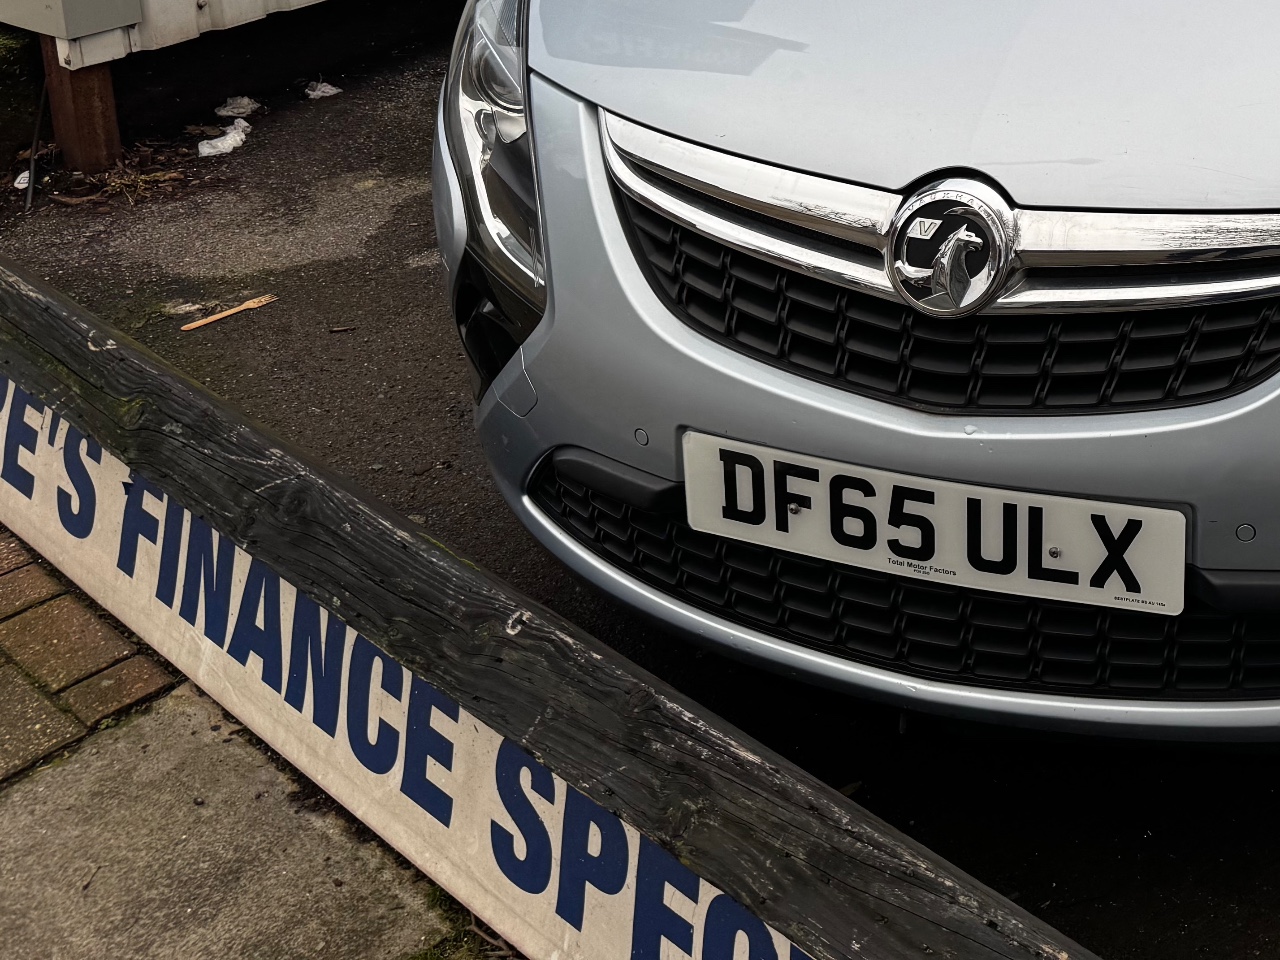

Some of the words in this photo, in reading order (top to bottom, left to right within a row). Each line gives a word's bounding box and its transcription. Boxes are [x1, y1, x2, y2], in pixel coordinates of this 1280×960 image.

[719, 448, 936, 563] DF65
[966, 496, 1143, 595] ULX
[887, 557, 905, 567] Total
[906, 561, 928, 571] Motor
[929, 565, 957, 576] Factors
[0, 372, 102, 539] E'S
[117, 470, 460, 829] FINANCE
[490, 738, 821, 960] SPE
